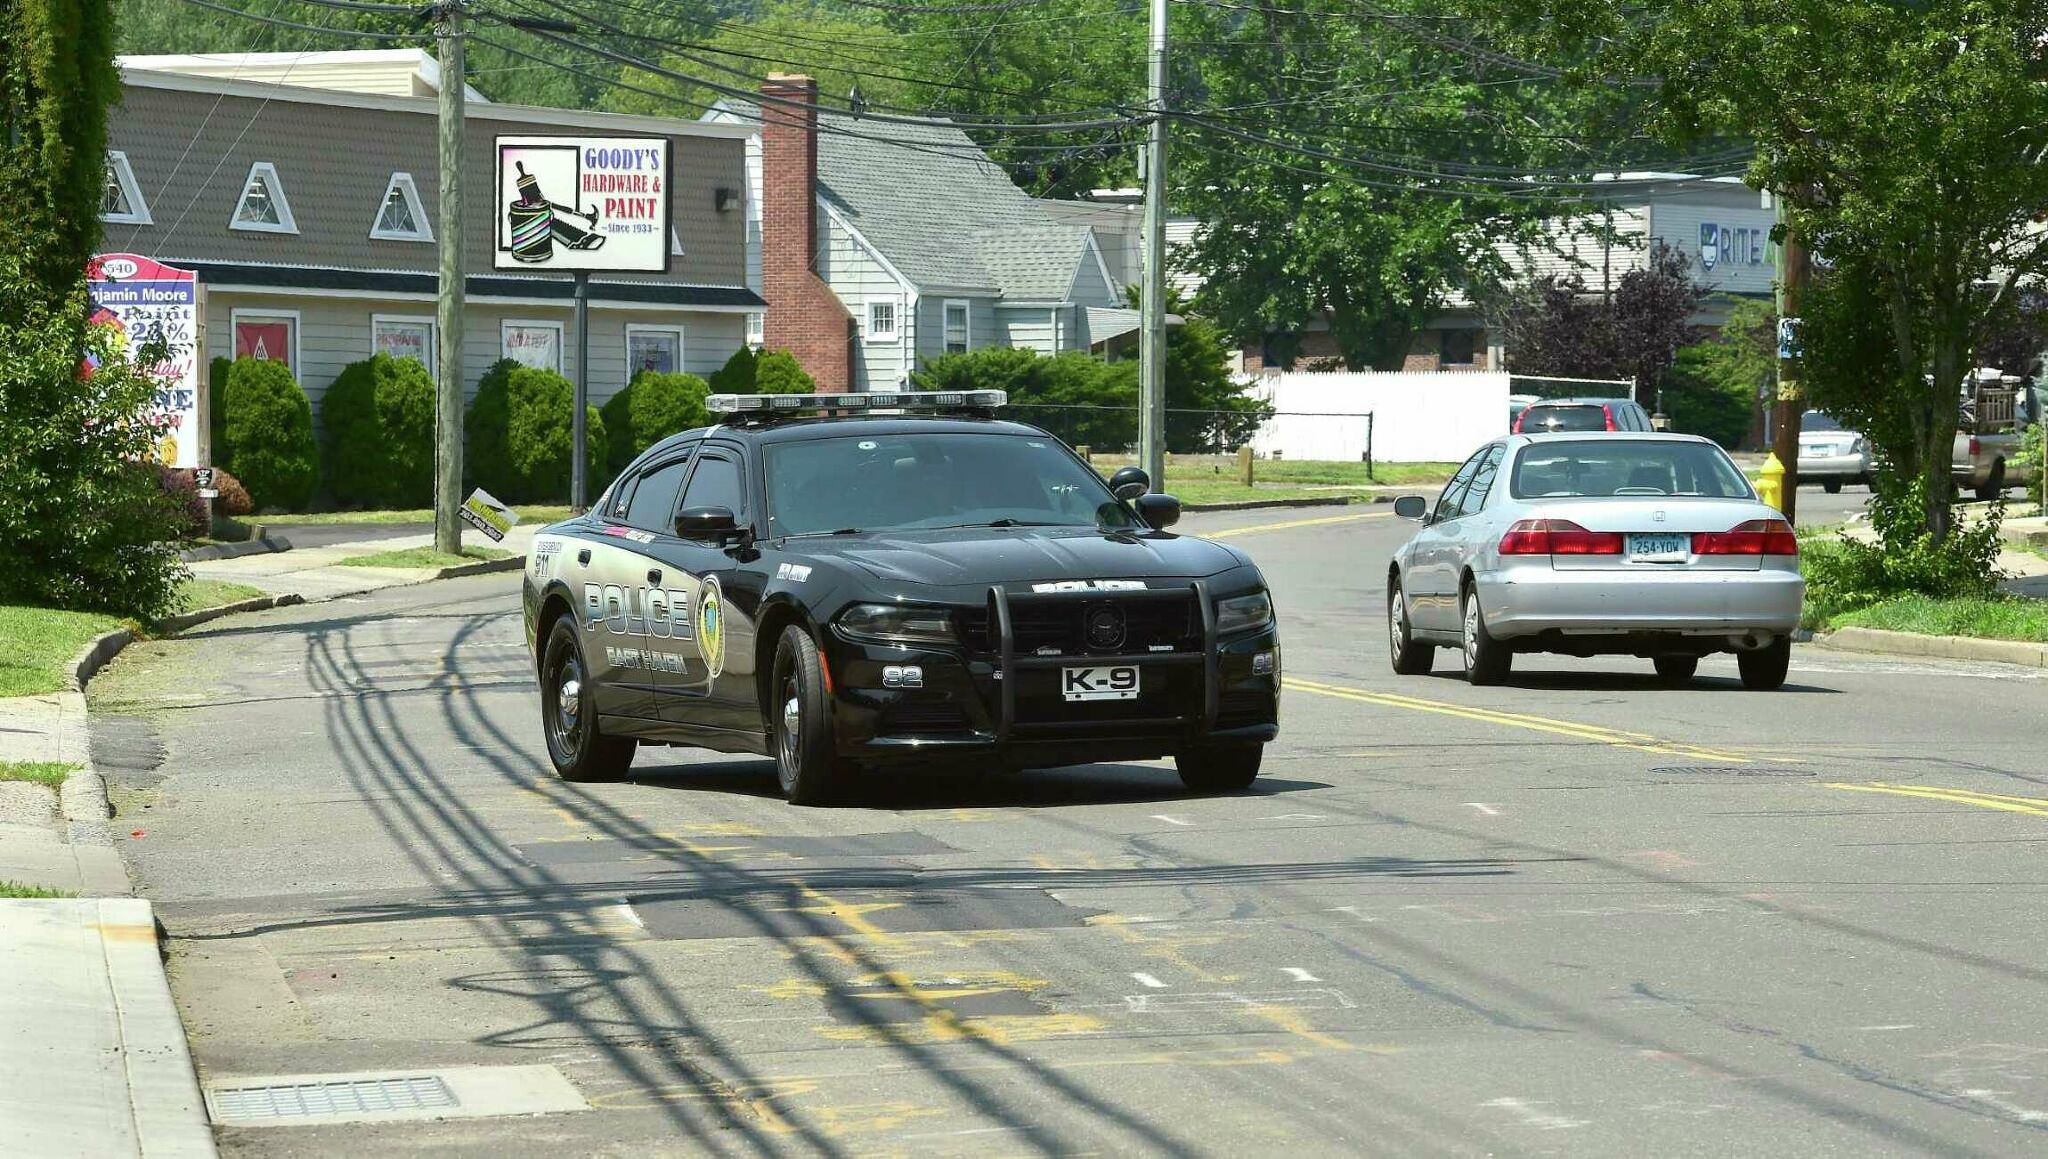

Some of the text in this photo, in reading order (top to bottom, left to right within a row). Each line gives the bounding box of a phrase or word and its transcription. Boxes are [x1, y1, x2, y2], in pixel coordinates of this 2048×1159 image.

[585, 148, 660, 170] GOODY'S
[583, 174, 661, 193] HARDWARE &
[605, 198, 657, 219] PAINT
[1720, 227, 1760, 264] RITE
[107, 263, 133, 273] 540
[142, 287, 188, 301] Moore
[535, 553, 550, 577] 911
[584, 582, 693, 641] POLICE
[606, 646, 688, 675] EAST HAVEN
[882, 666, 923, 688] 92
[1066, 668, 1137, 692] K-9
